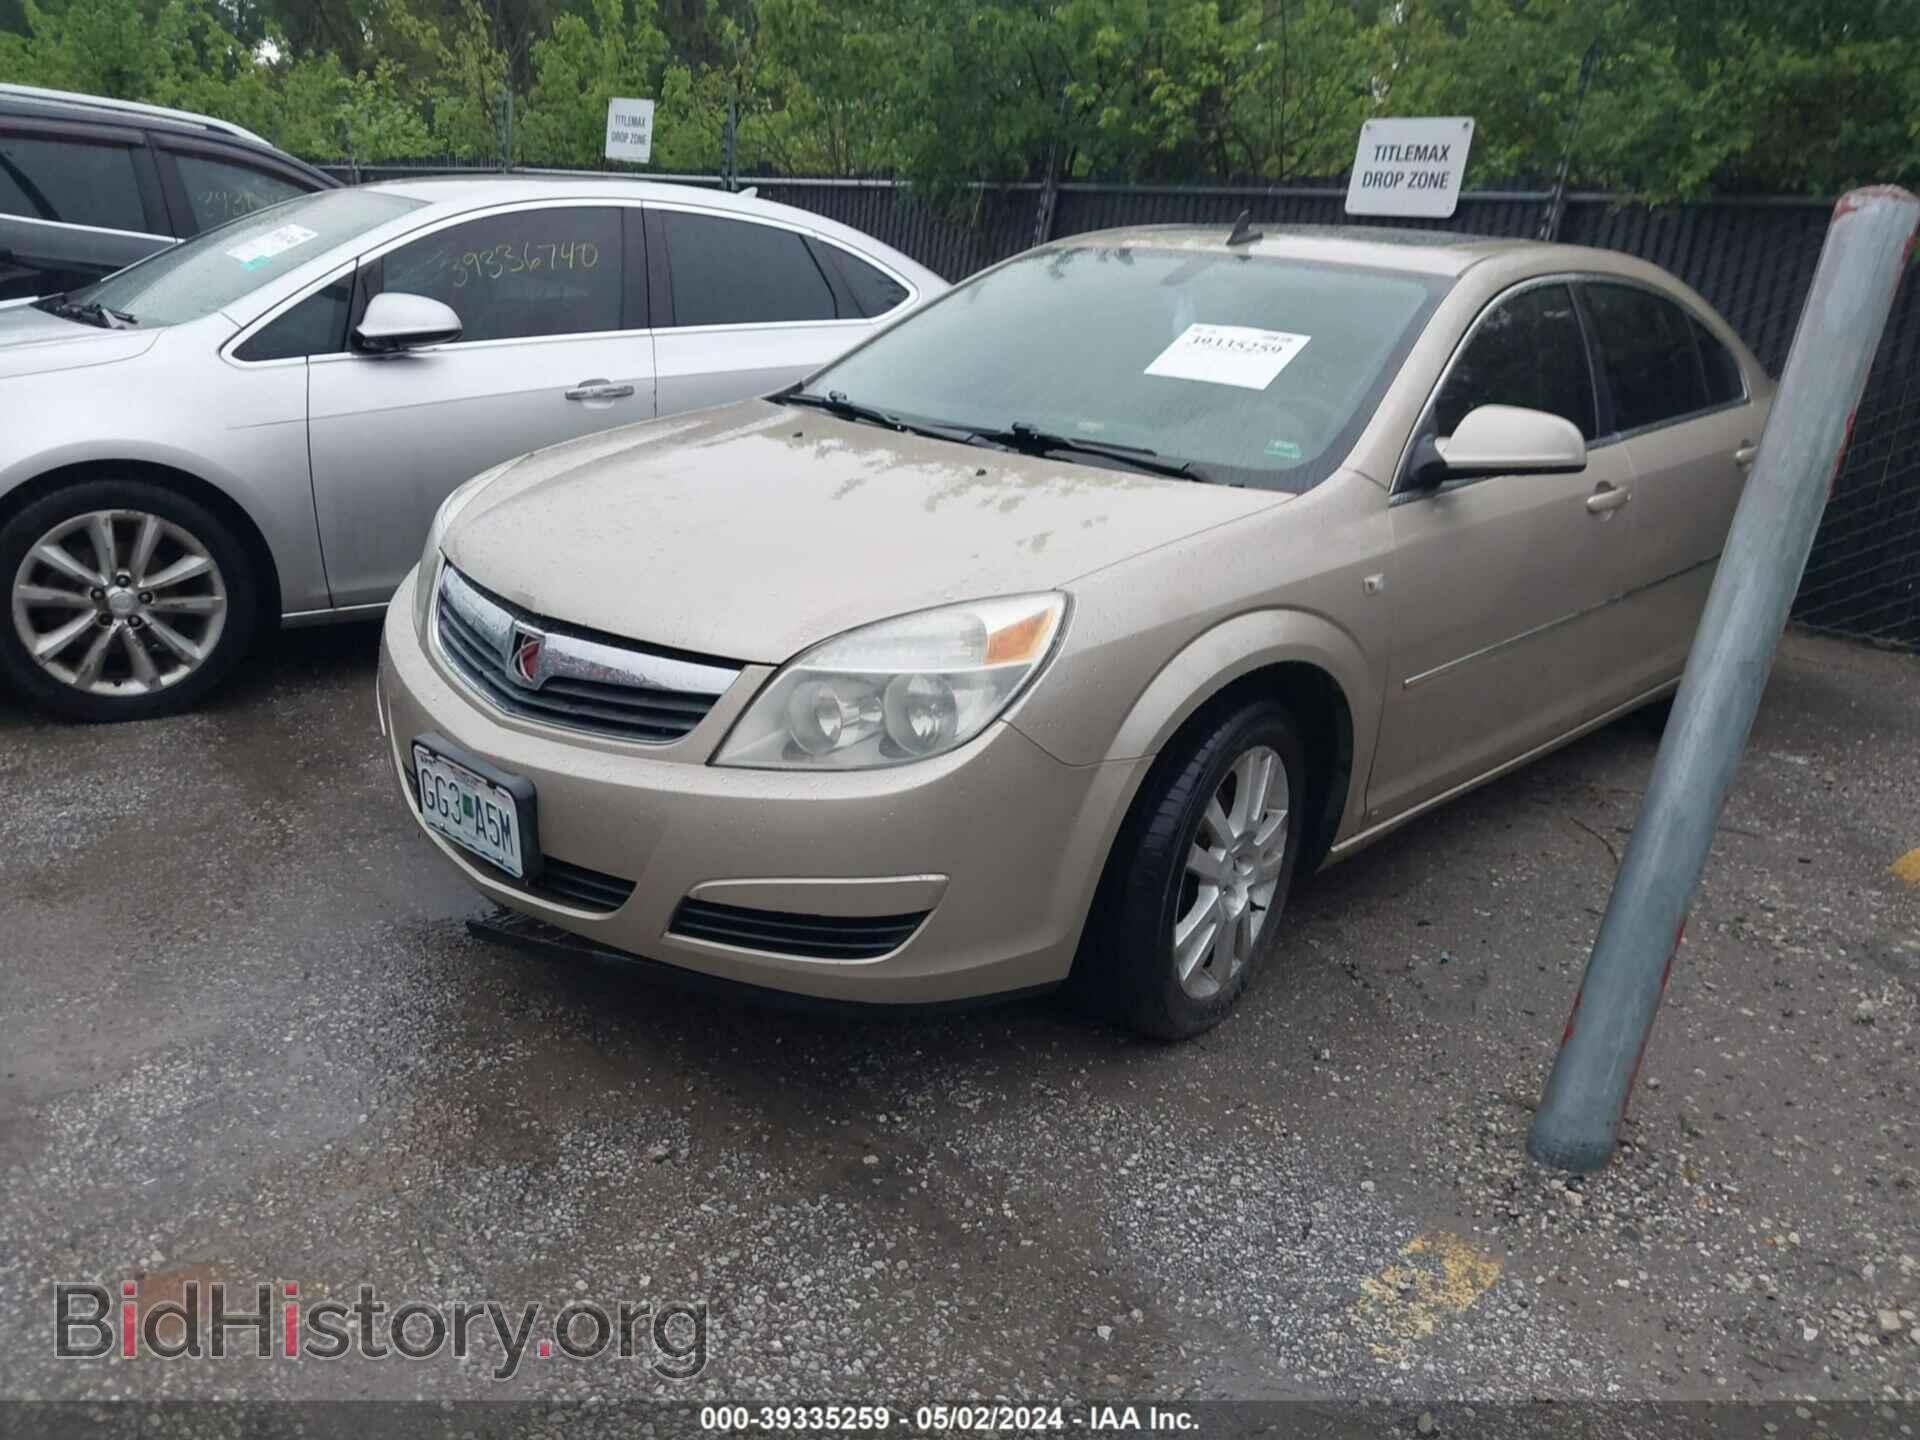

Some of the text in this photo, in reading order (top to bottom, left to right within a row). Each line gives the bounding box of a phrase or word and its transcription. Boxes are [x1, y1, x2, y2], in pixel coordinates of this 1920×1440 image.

[615, 114, 646, 127] TITLEMAX
[1374, 144, 1451, 162] TITLEMAX
[1362, 171, 1450, 189] DROP ZONE
[452, 241, 599, 288] 39336740
[421, 768, 514, 857] GG3 A5M
